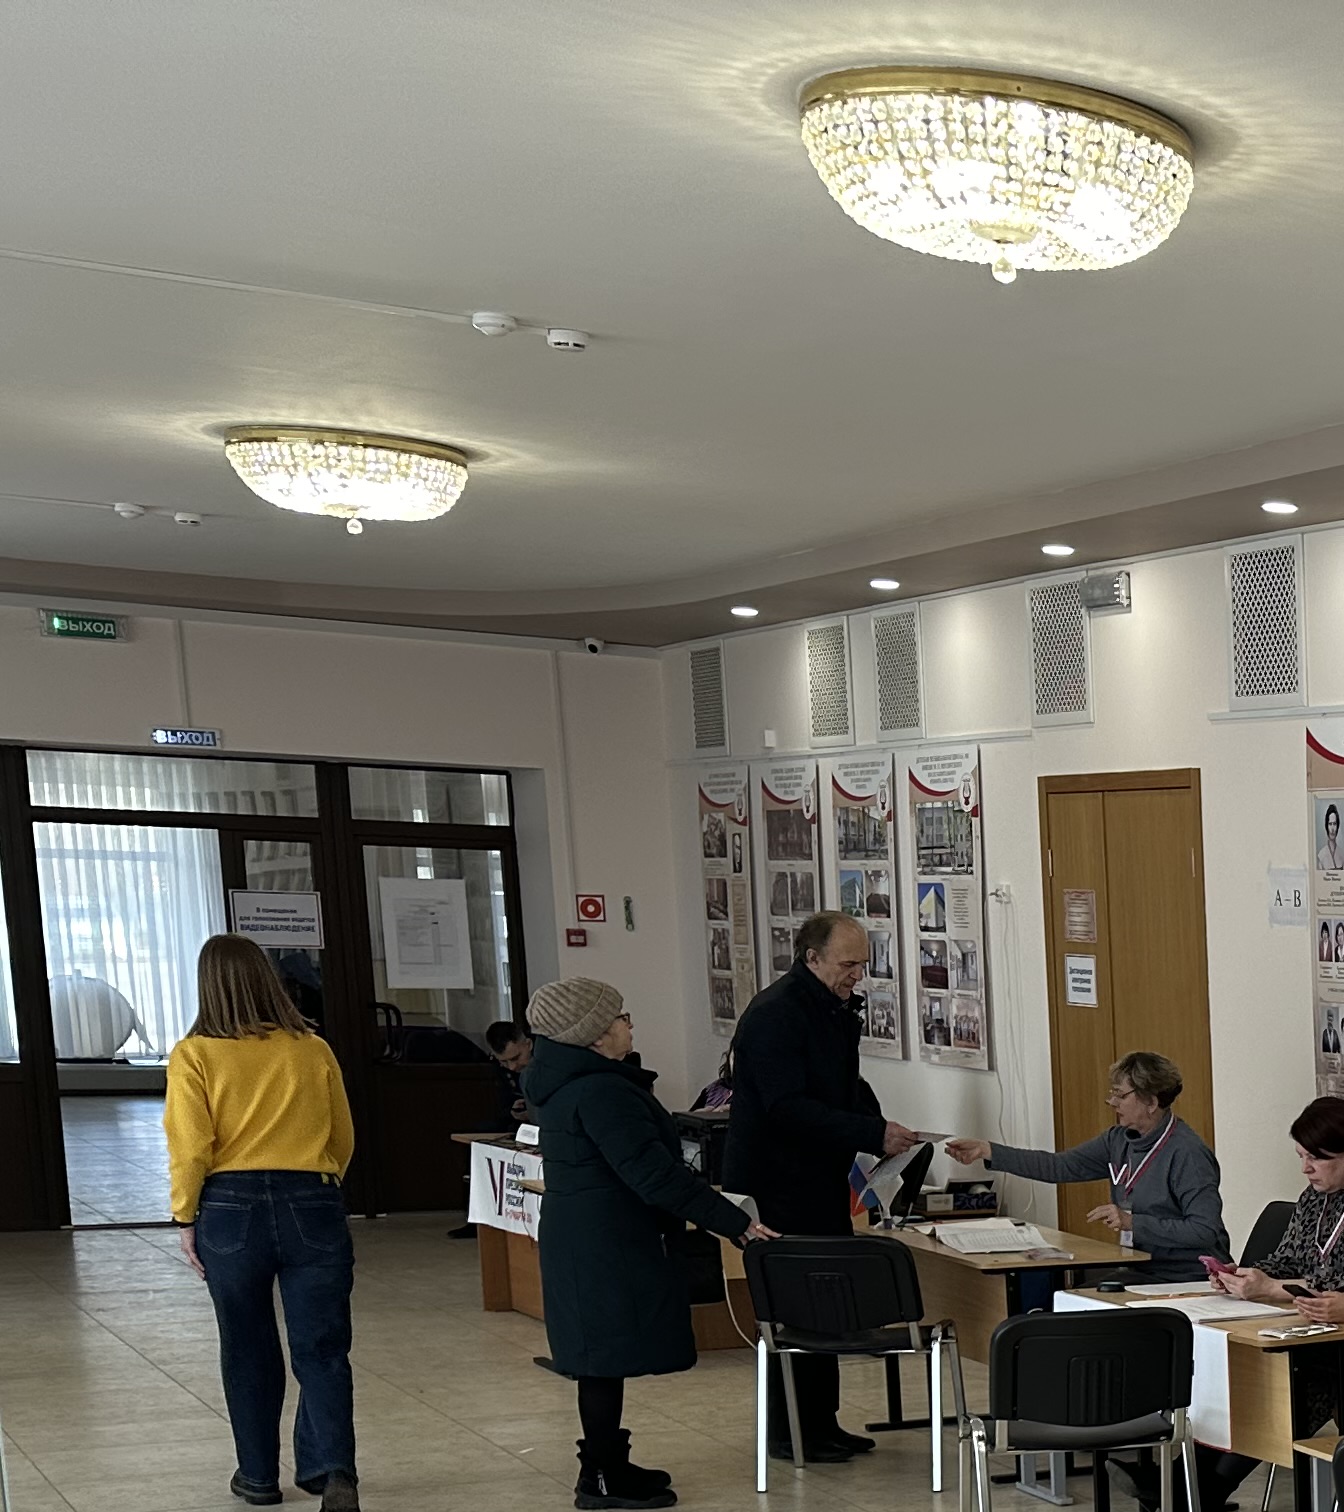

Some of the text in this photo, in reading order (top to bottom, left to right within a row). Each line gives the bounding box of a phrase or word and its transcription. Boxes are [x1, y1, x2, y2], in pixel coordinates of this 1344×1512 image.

[58, 619, 115, 636] ВЫХОД
[155, 729, 214, 745] ВЫХОД
[1273, 889, 1283, 907] А
[1293, 889, 1302, 908] В
